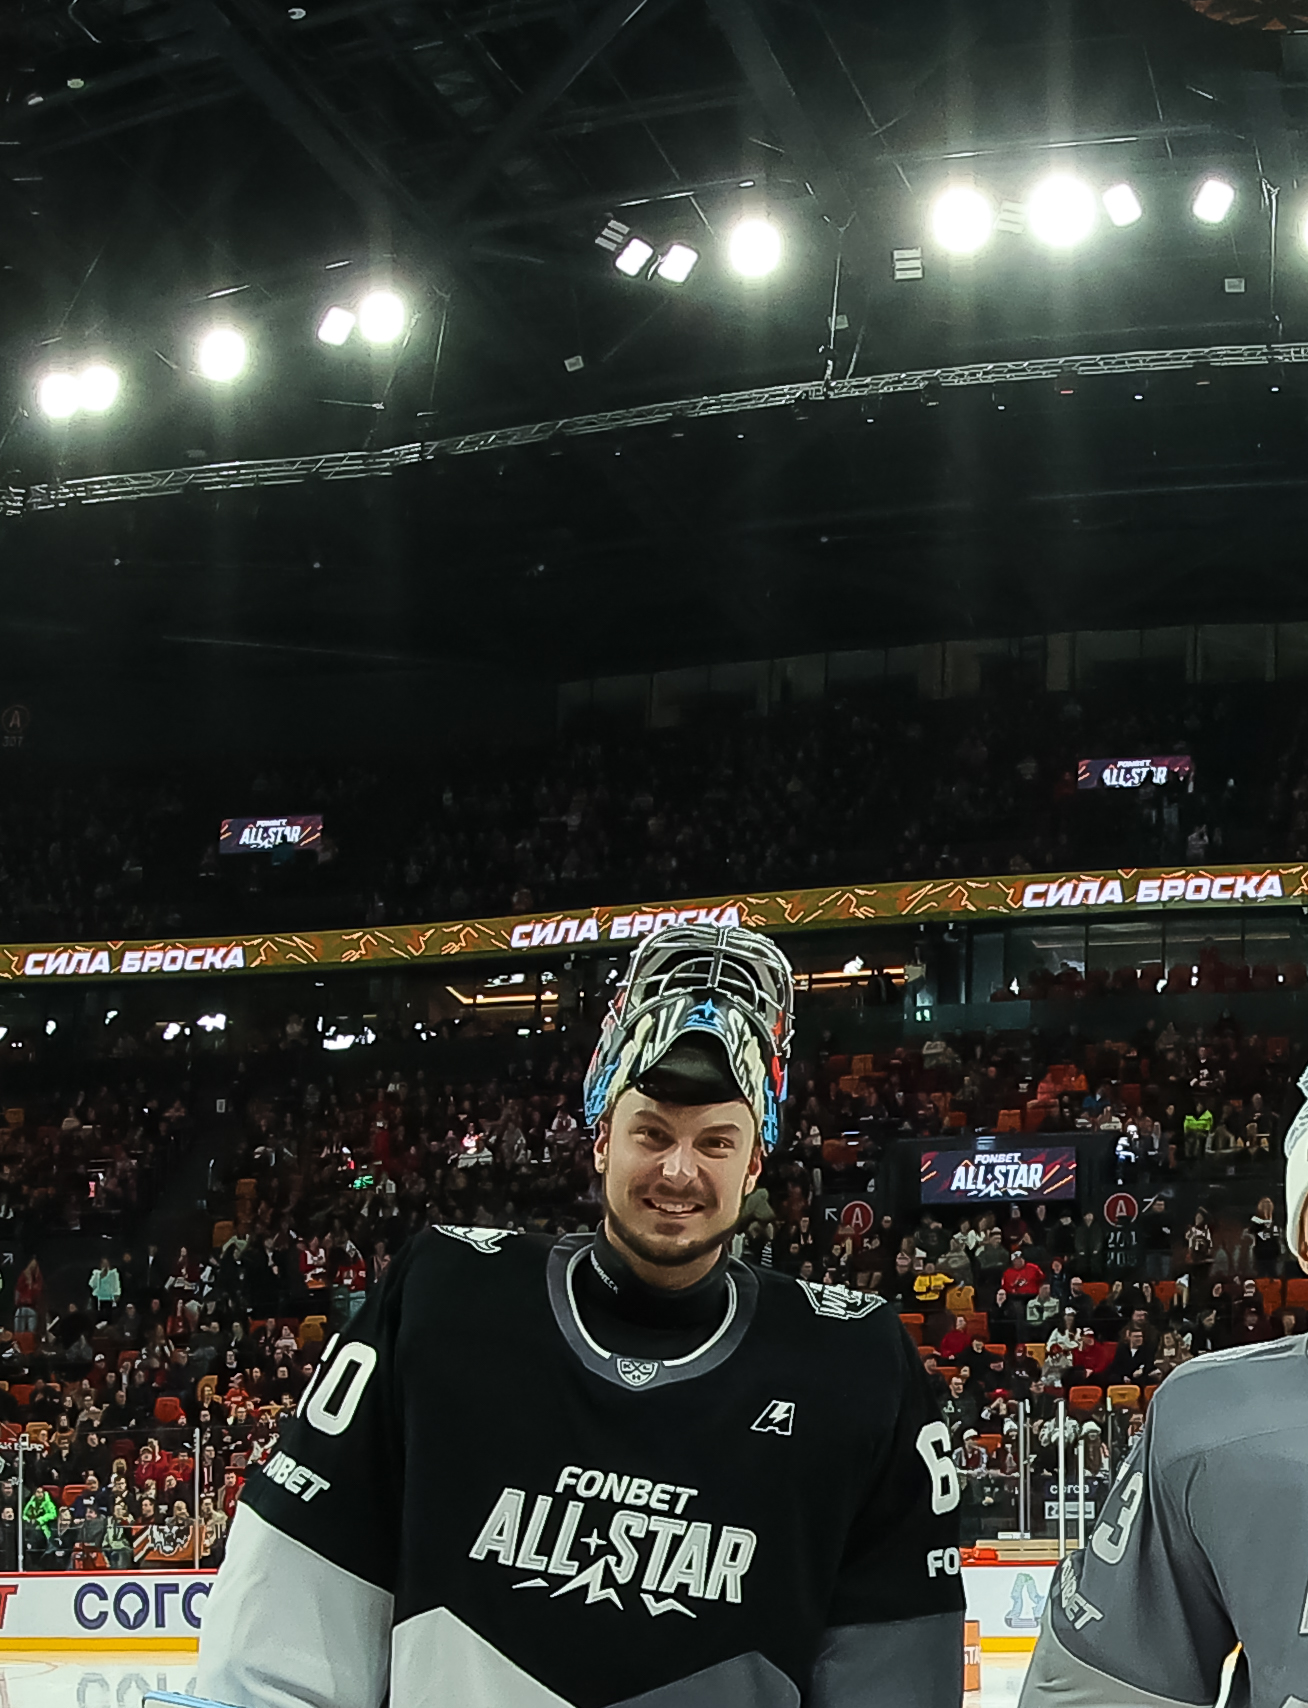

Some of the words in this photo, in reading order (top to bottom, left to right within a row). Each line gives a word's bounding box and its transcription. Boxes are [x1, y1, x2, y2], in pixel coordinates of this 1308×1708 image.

[1022, 879, 1123, 908] СИЛА
[1136, 874, 1283, 903] БРОСКА
[510, 917, 599, 948] СИЛА
[24, 951, 110, 975] СИЛА
[120, 947, 244, 972] БРОСКА
[974, 1152, 1022, 1164] FONBET
[950, 1165, 987, 1191] ALL
[993, 1163, 1043, 1190] STAR
[916, 1421, 961, 1515] 6
[555, 1466, 699, 1515] FONBET
[468, 1487, 584, 1578] ALL
[607, 1509, 757, 1603] STAR
[927, 1548, 960, 1575] FO
